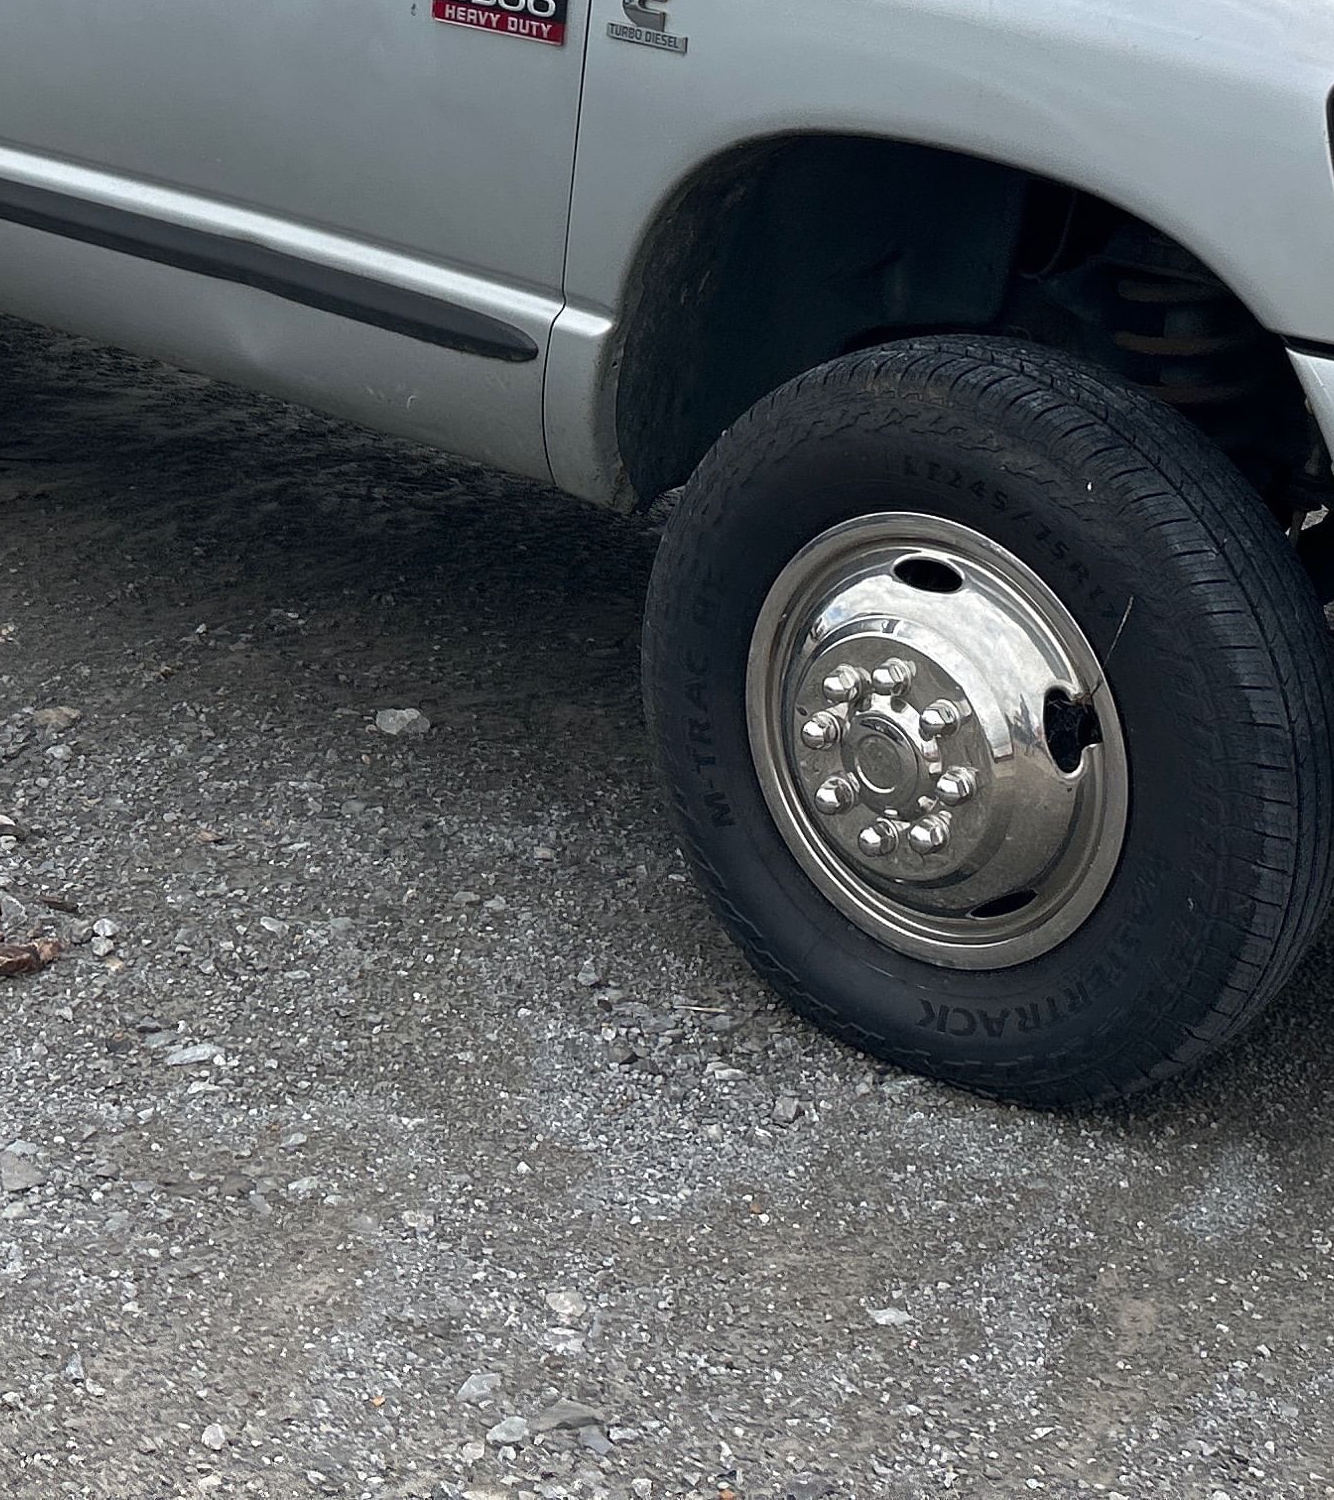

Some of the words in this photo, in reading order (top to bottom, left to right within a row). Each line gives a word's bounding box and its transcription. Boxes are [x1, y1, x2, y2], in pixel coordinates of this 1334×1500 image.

[445, 4, 501, 29] HEAVY
[507, 16, 552, 39] DUTY
[610, 23, 642, 41] TURBO
[645, 31, 679, 49] DIESEL
